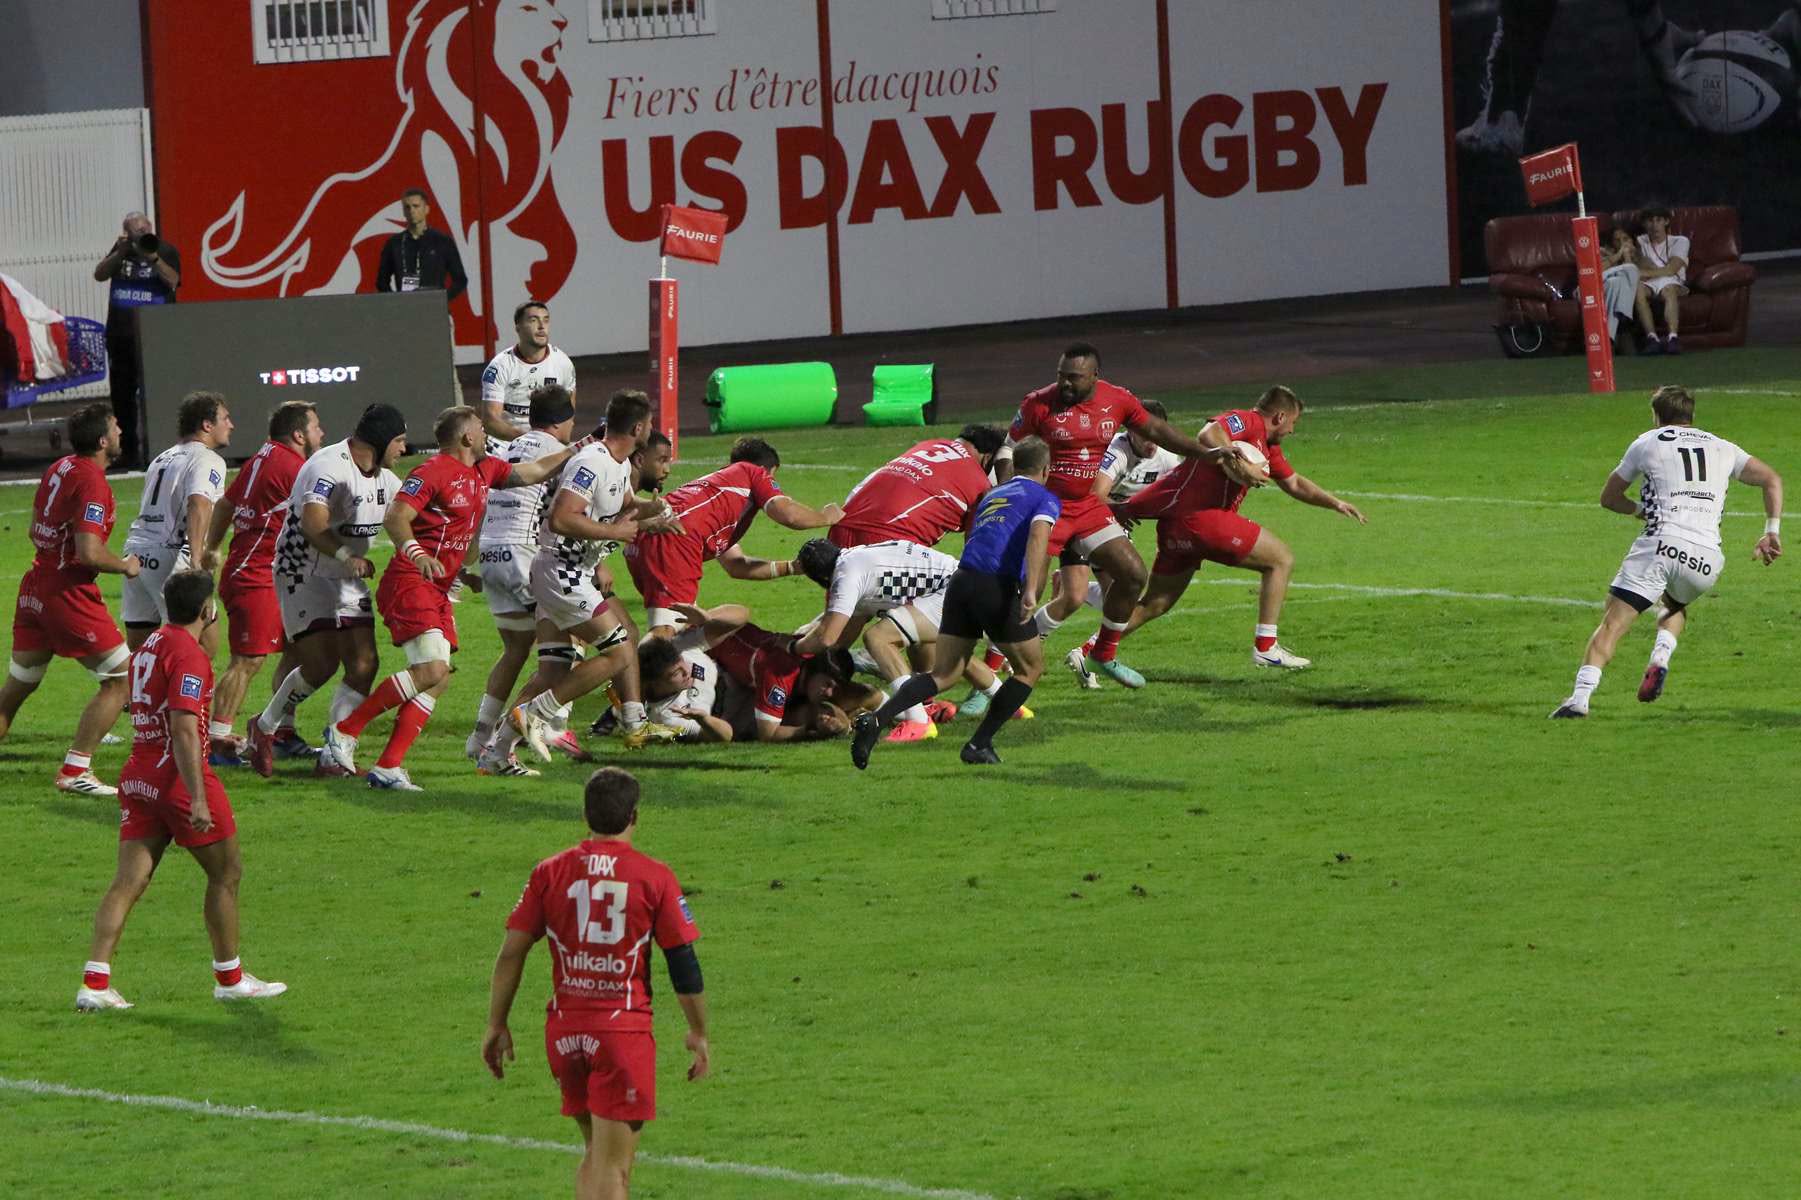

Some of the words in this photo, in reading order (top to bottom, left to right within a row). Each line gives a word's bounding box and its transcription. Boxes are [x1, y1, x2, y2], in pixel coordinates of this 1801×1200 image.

[602, 76, 701, 120] Fiers
[832, 53, 1000, 113] dacquois
[602, 130, 748, 242] US
[776, 111, 1002, 230] DAX
[1030, 82, 1389, 212] RUGBY
[1530, 163, 1574, 185] FAURIE
[666, 224, 719, 244] FAURIE
[286, 365, 361, 385] TISSOT
[912, 443, 962, 463] 3
[1677, 447, 1707, 482] 11
[43, 472, 62, 518] 7
[150, 468, 166, 506] 1
[243, 457, 263, 500] 1
[1655, 540, 1713, 576] koesio
[131, 651, 158, 706] 12
[587, 854, 619, 878] DAX
[566, 879, 630, 946] 13
[598, 979, 625, 993] DAX
